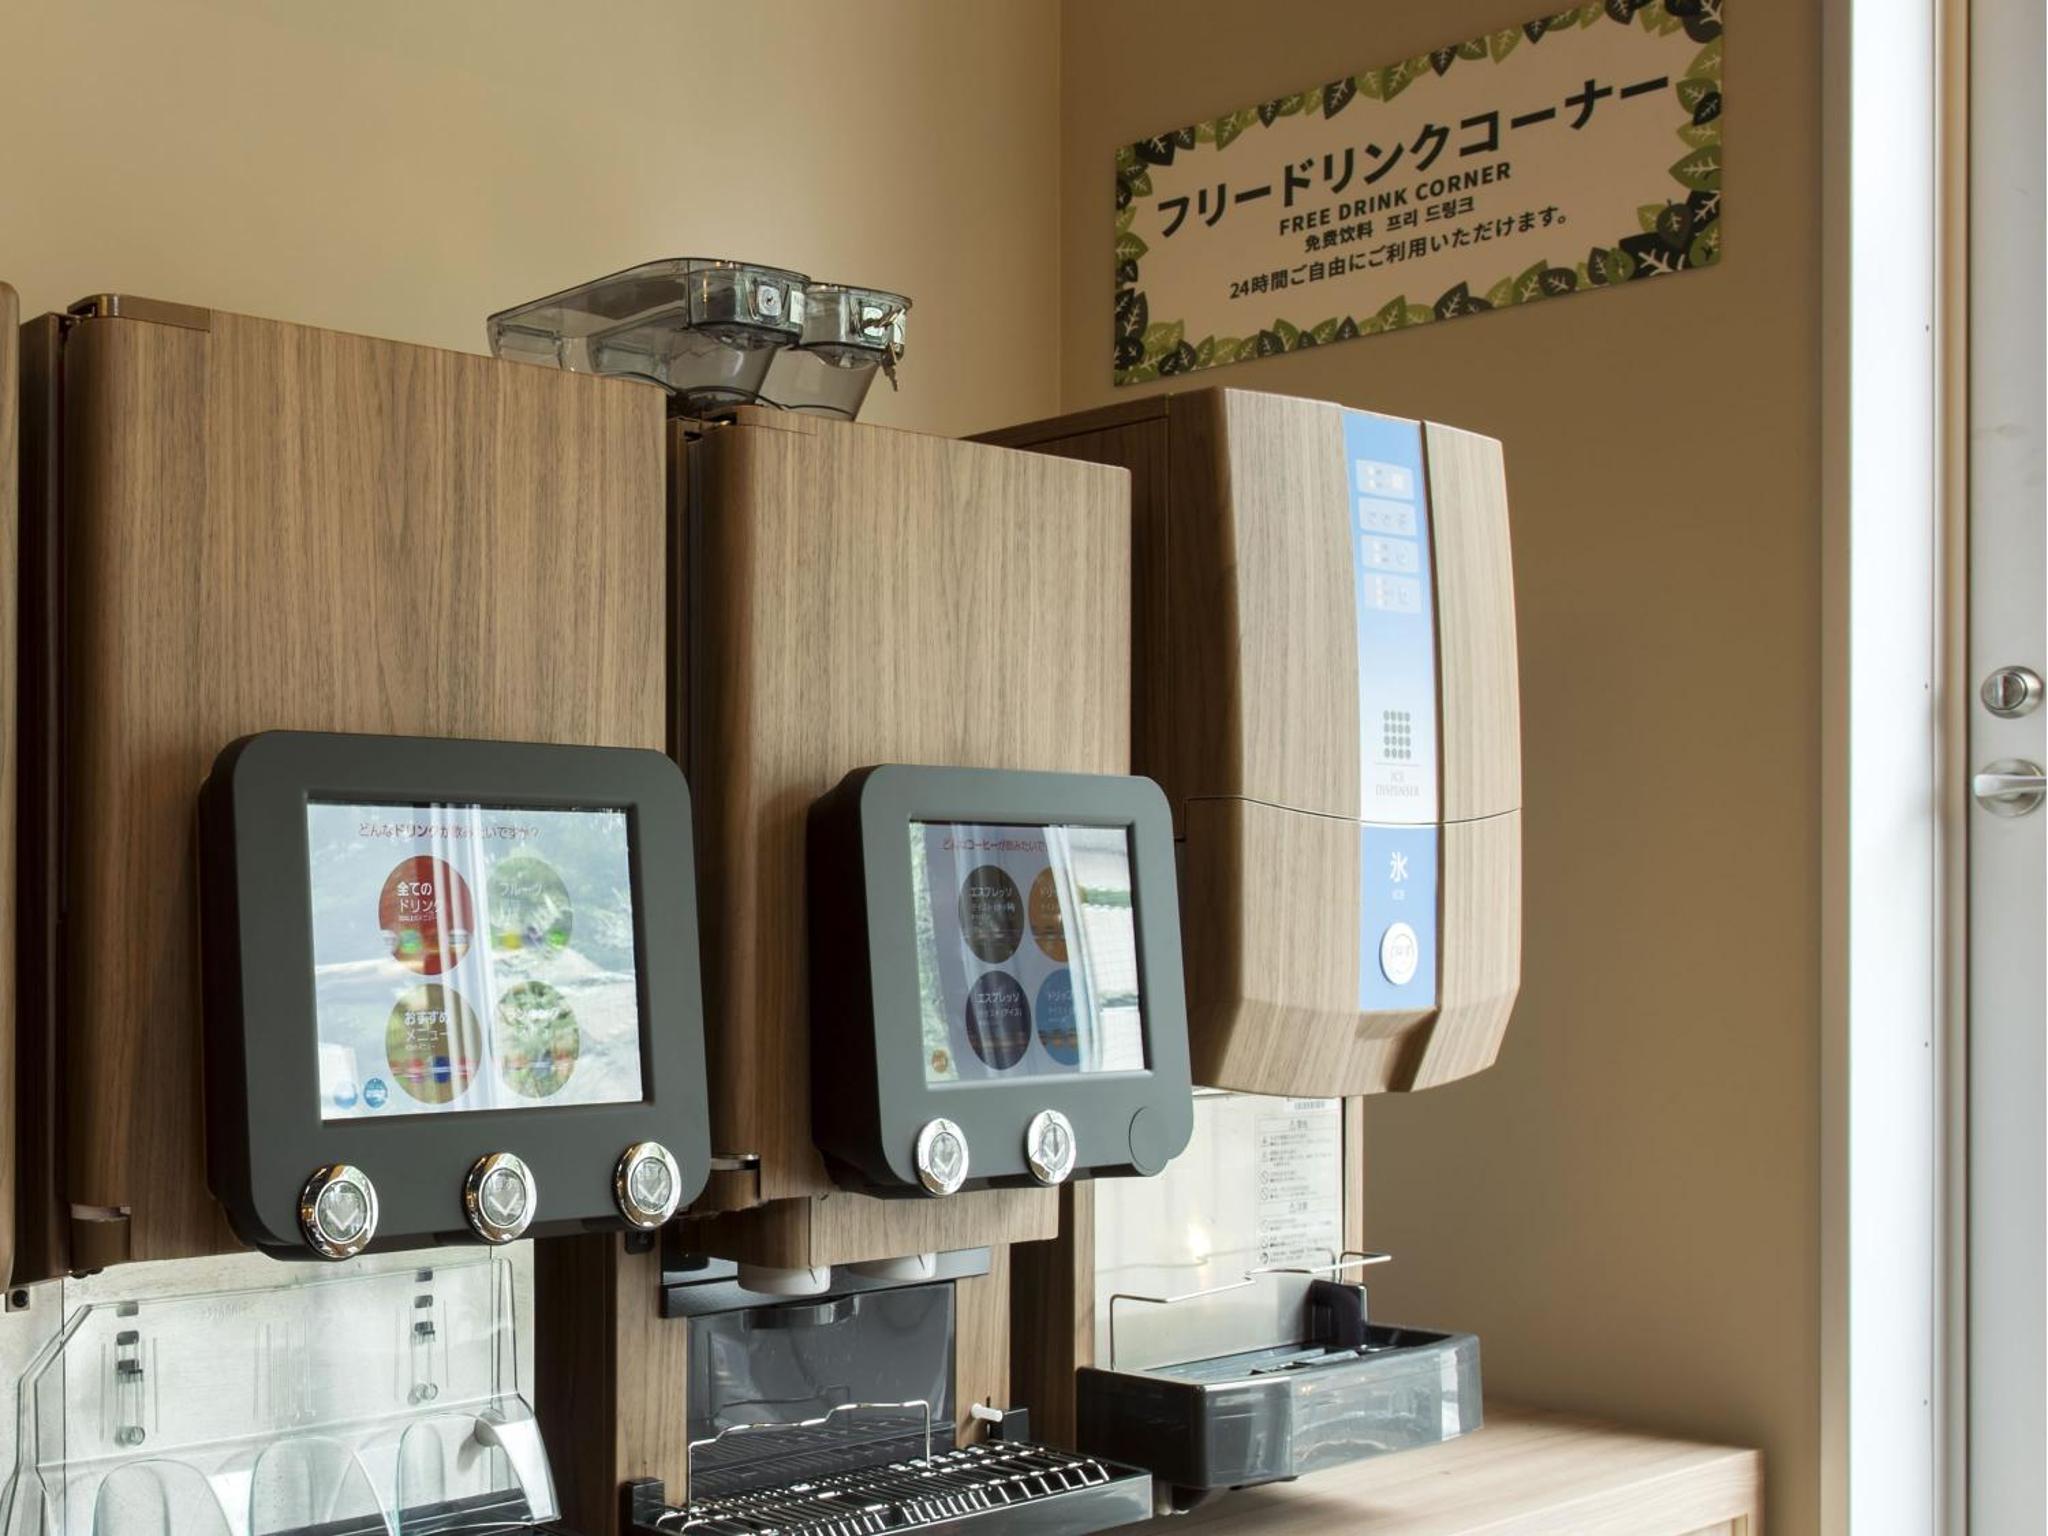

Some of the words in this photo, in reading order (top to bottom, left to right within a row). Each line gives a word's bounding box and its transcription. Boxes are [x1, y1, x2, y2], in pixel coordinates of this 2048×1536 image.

[1158, 75, 1670, 238] フリードリンクコーナー
[1279, 208, 1331, 236] FREE
[1339, 188, 1408, 221] DRINK
[1415, 162, 1511, 200] CORNER
[1386, 209, 1418, 232] 프리
[1425, 196, 1475, 222] 드링크
[1230, 206, 1568, 299] 24時間ご自由にご利用いただけます。
[1305, 221, 1373, 253] 免费饮料
[1390, 851, 1409, 883] 氷
[397, 881, 432, 896] 全ての
[406, 1028, 447, 1041] メニュー
